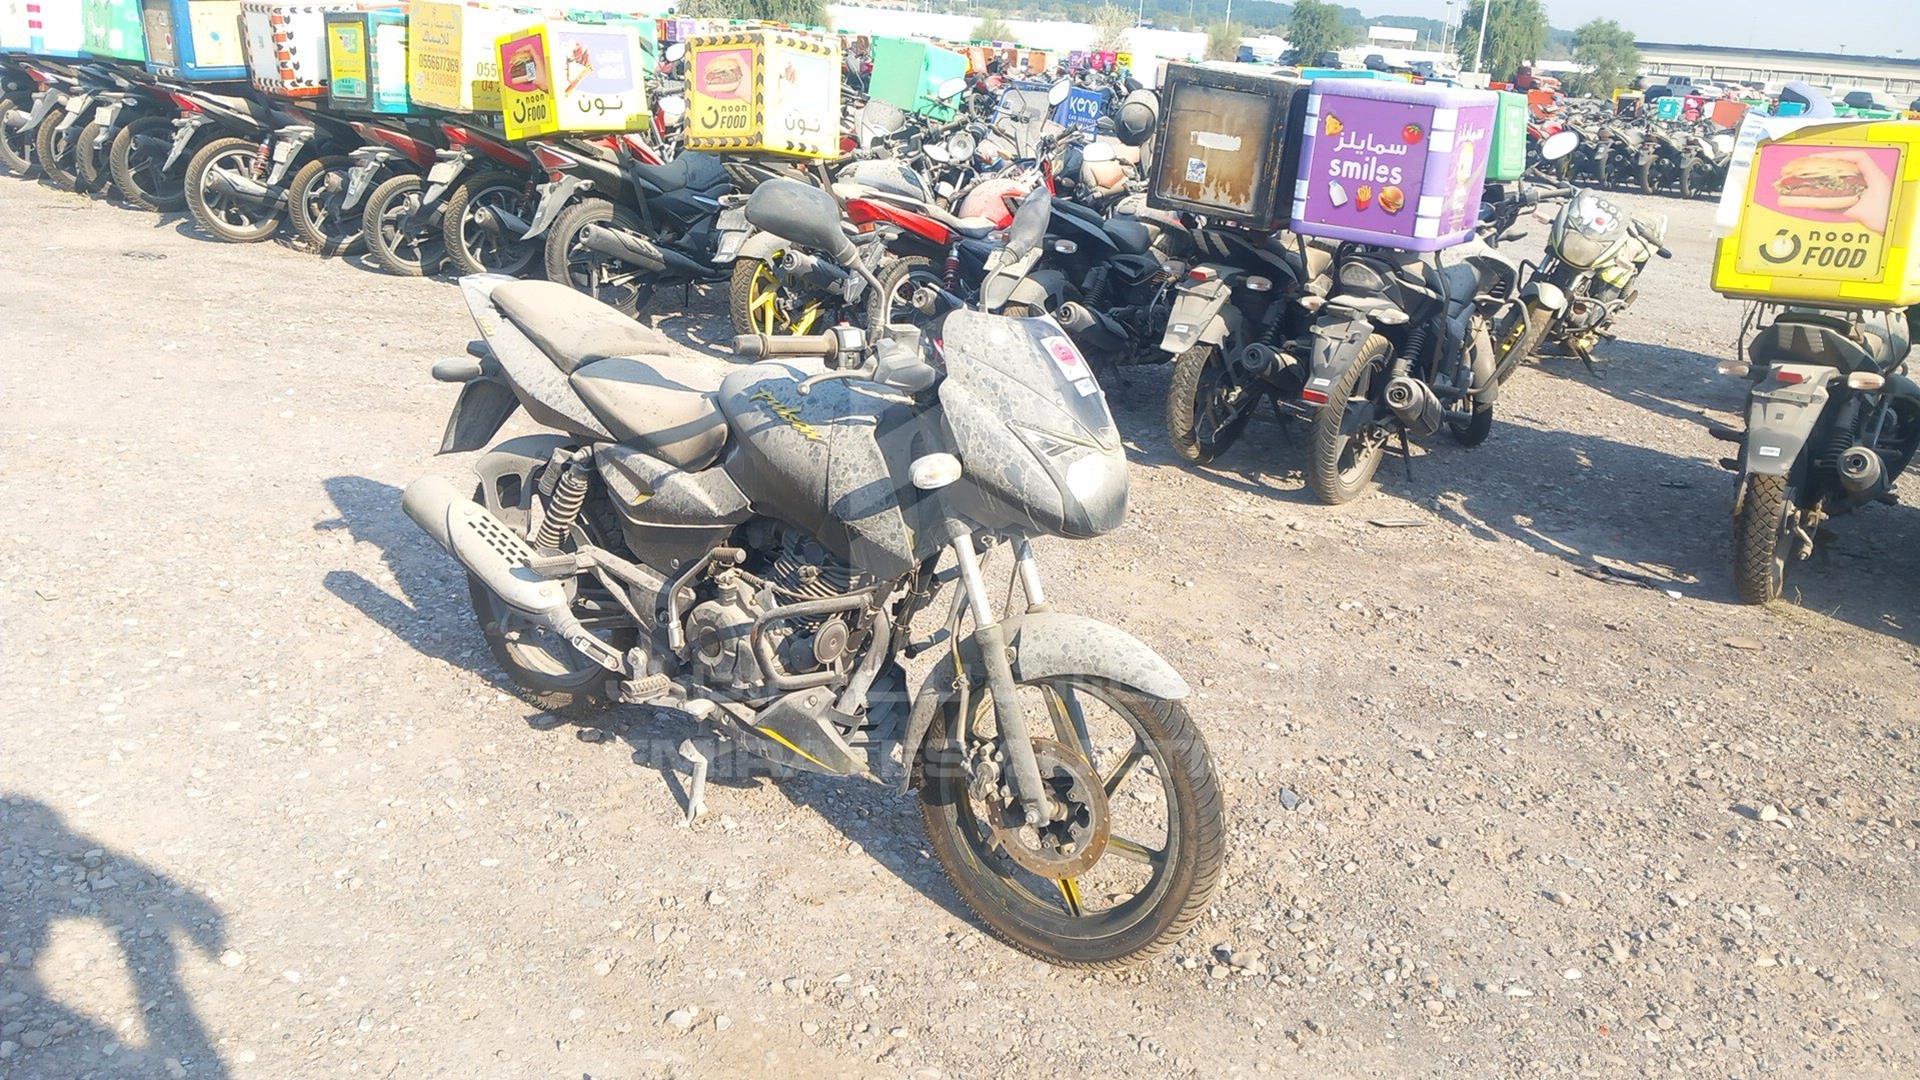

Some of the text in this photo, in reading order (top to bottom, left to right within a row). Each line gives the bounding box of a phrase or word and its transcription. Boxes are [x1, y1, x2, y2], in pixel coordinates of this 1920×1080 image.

[476, 61, 498, 78] 055
[525, 94, 545, 104] noon
[578, 94, 623, 116] نون
[527, 105, 547, 122] FOOD
[721, 104, 748, 113] noon
[720, 115, 747, 129] FOOD
[1333, 131, 1408, 156] سمايلز
[1328, 156, 1402, 185] smiles
[1809, 230, 1870, 244] noon
[1802, 246, 1867, 268] FOOD
